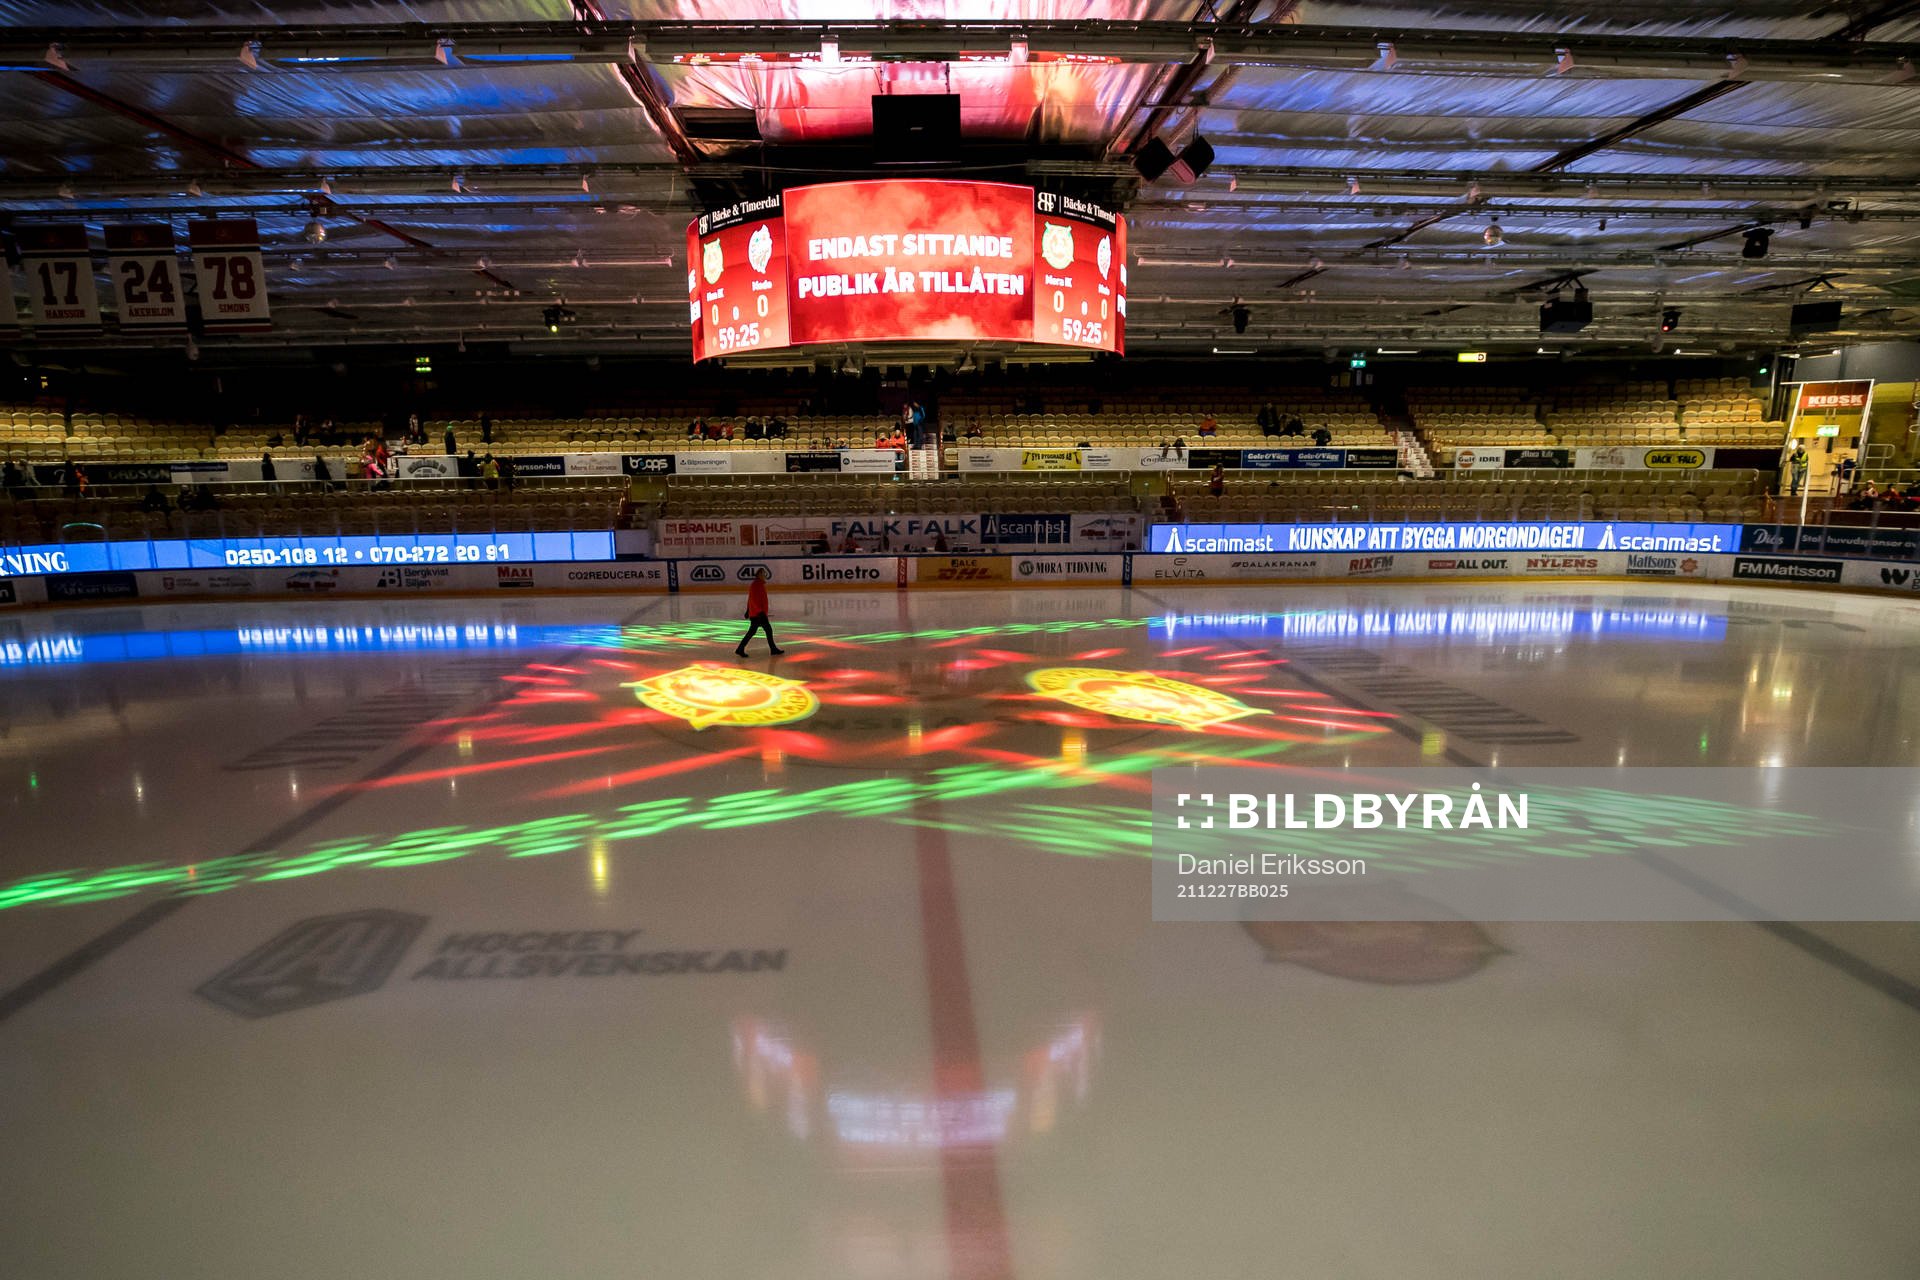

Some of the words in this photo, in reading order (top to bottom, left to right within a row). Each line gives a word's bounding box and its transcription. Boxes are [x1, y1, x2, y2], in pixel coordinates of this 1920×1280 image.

[712, 207, 731, 223] Bäcke
[732, 204, 740, 216] &
[740, 194, 780, 214] Timerdal
[1063, 196, 1086, 214] Bäcke
[1087, 203, 1093, 214] &
[808, 235, 898, 260] ENDAST
[902, 233, 1013, 259] SITTANDE
[38, 261, 79, 305] 17
[121, 260, 175, 303] 24
[204, 256, 256, 300] 78
[798, 273, 878, 299] PUBLIK
[882, 265, 915, 294] ÄR
[918, 265, 1025, 296] TILLÅTEN
[218, 303, 250, 313] SIMONS
[757, 294, 769, 317] 0
[1053, 290, 1064, 313] 0
[1101, 298, 1108, 320] 0
[712, 304, 719, 326] 0
[718, 322, 760, 350] 59:25
[1062, 318, 1103, 344] 59:25
[1807, 394, 1865, 405] KIOSK
[832, 520, 900, 536] FALK
[908, 519, 976, 535] FALK
[1000, 521, 1068, 535] scanmast
[1186, 534, 1273, 552] scanmast
[1289, 527, 1366, 550] KUNSKAP
[1369, 527, 1400, 549] ATT
[1402, 527, 1455, 549] BYGGA
[1459, 527, 1585, 550] MORGONDAGEN
[1620, 534, 1722, 552] scanmast
[225, 548, 317, 565] 0250-108
[323, 548, 348, 564] 12
[370, 545, 449, 563] 070-272
[455, 545, 480, 561] 20
[486, 543, 510, 561] 91
[1627, 554, 1677, 569] Mattsons
[802, 563, 880, 581] Bilmetro
[1036, 562, 1062, 574] MORA
[1066, 562, 1107, 574] TIDNING
[1242, 560, 1317, 568] DALAKRANAR
[1457, 560, 1478, 569] ALL
[1482, 559, 1508, 569] OUT.
[1527, 559, 1598, 568] NYLENS
[1738, 562, 1762, 574] FM
[1764, 564, 1836, 578] Mattsson
[404, 568, 449, 578] Bergkvist
[937, 568, 992, 580] DHL
[1154, 569, 1205, 578] ELVITA
[439, 928, 643, 953] HOCKEY
[411, 949, 788, 981] ALLSVENSKAN
